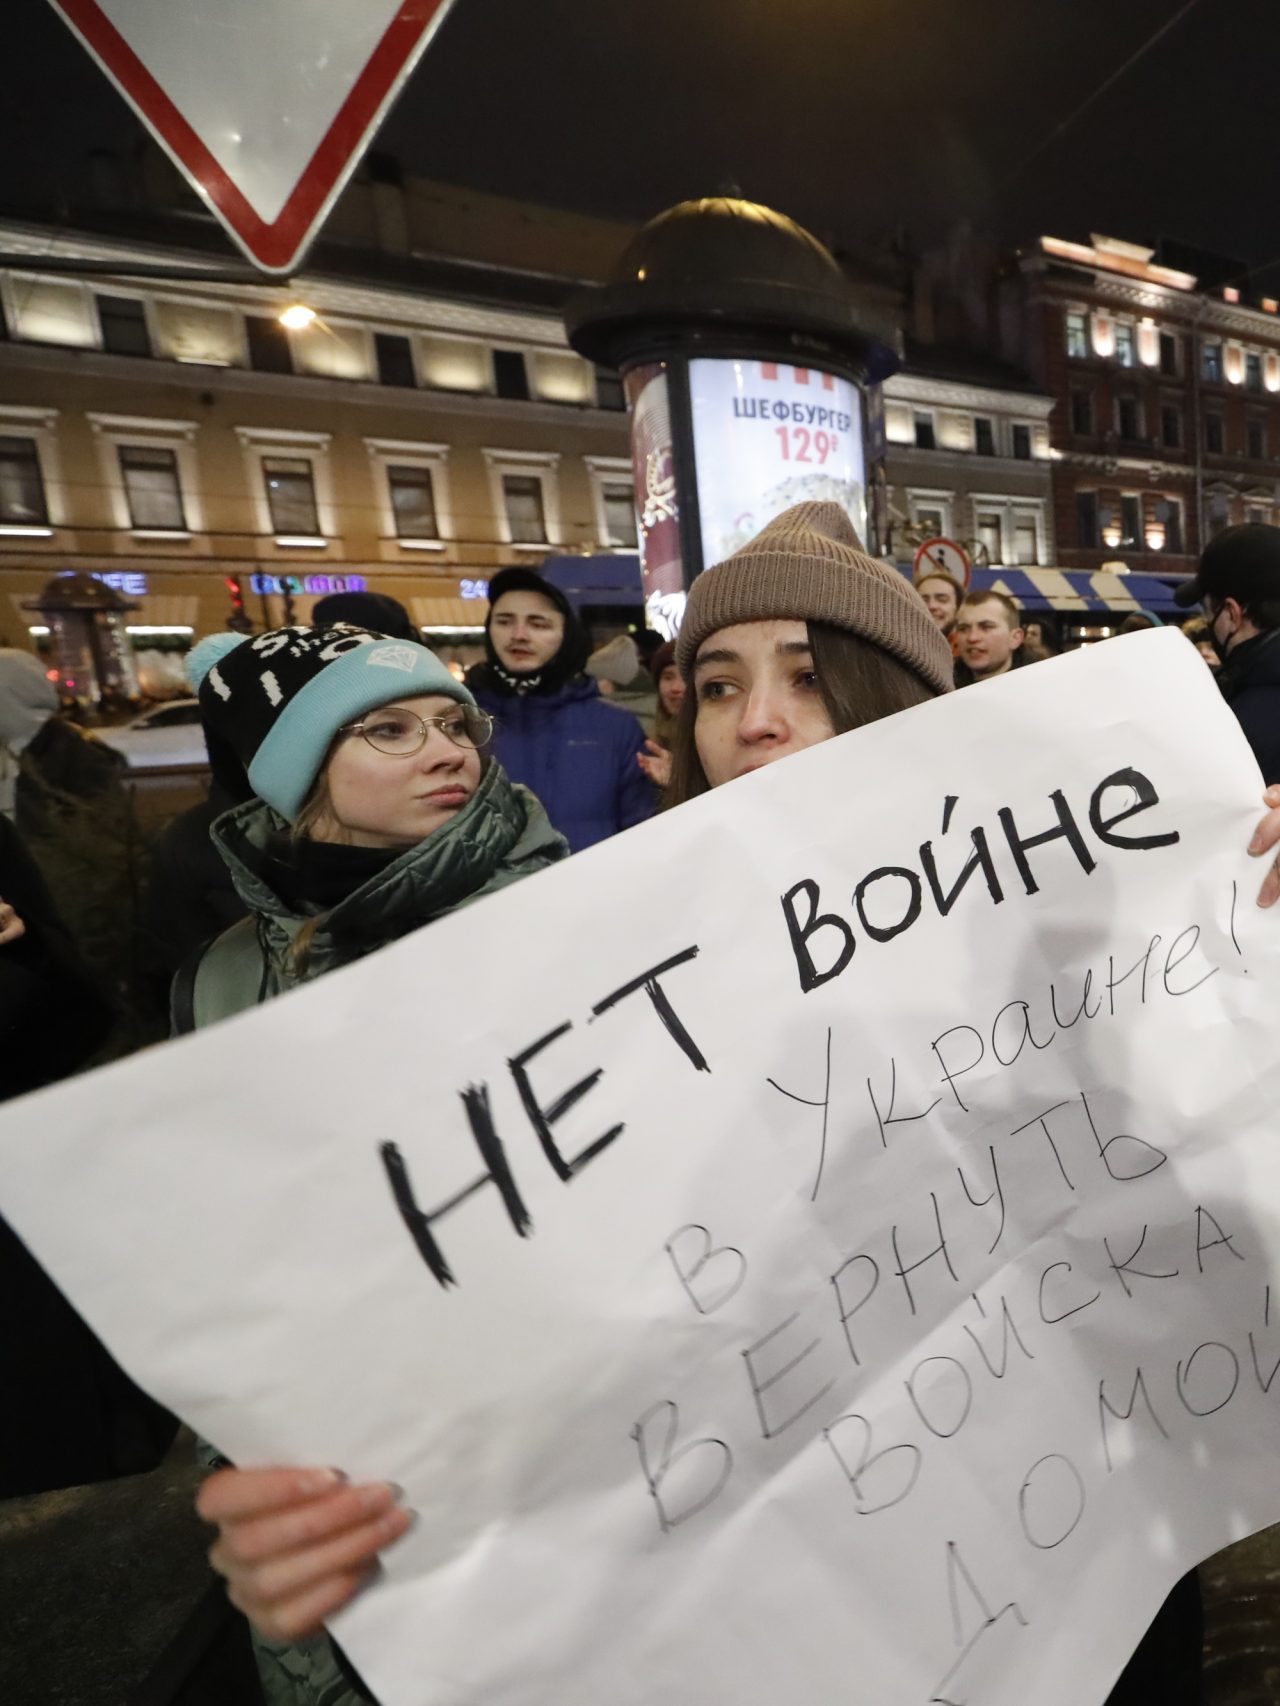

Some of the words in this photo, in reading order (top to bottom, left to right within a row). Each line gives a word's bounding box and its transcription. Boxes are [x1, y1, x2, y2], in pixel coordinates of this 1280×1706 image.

[733, 397, 852, 432] ШЕФБУРГЕР
[378, 944, 712, 1292] НЕТ
[629, 1092, 1168, 1533] ВЕРНУТЬ
[822, 1205, 1245, 1515] ВОЙСКА
